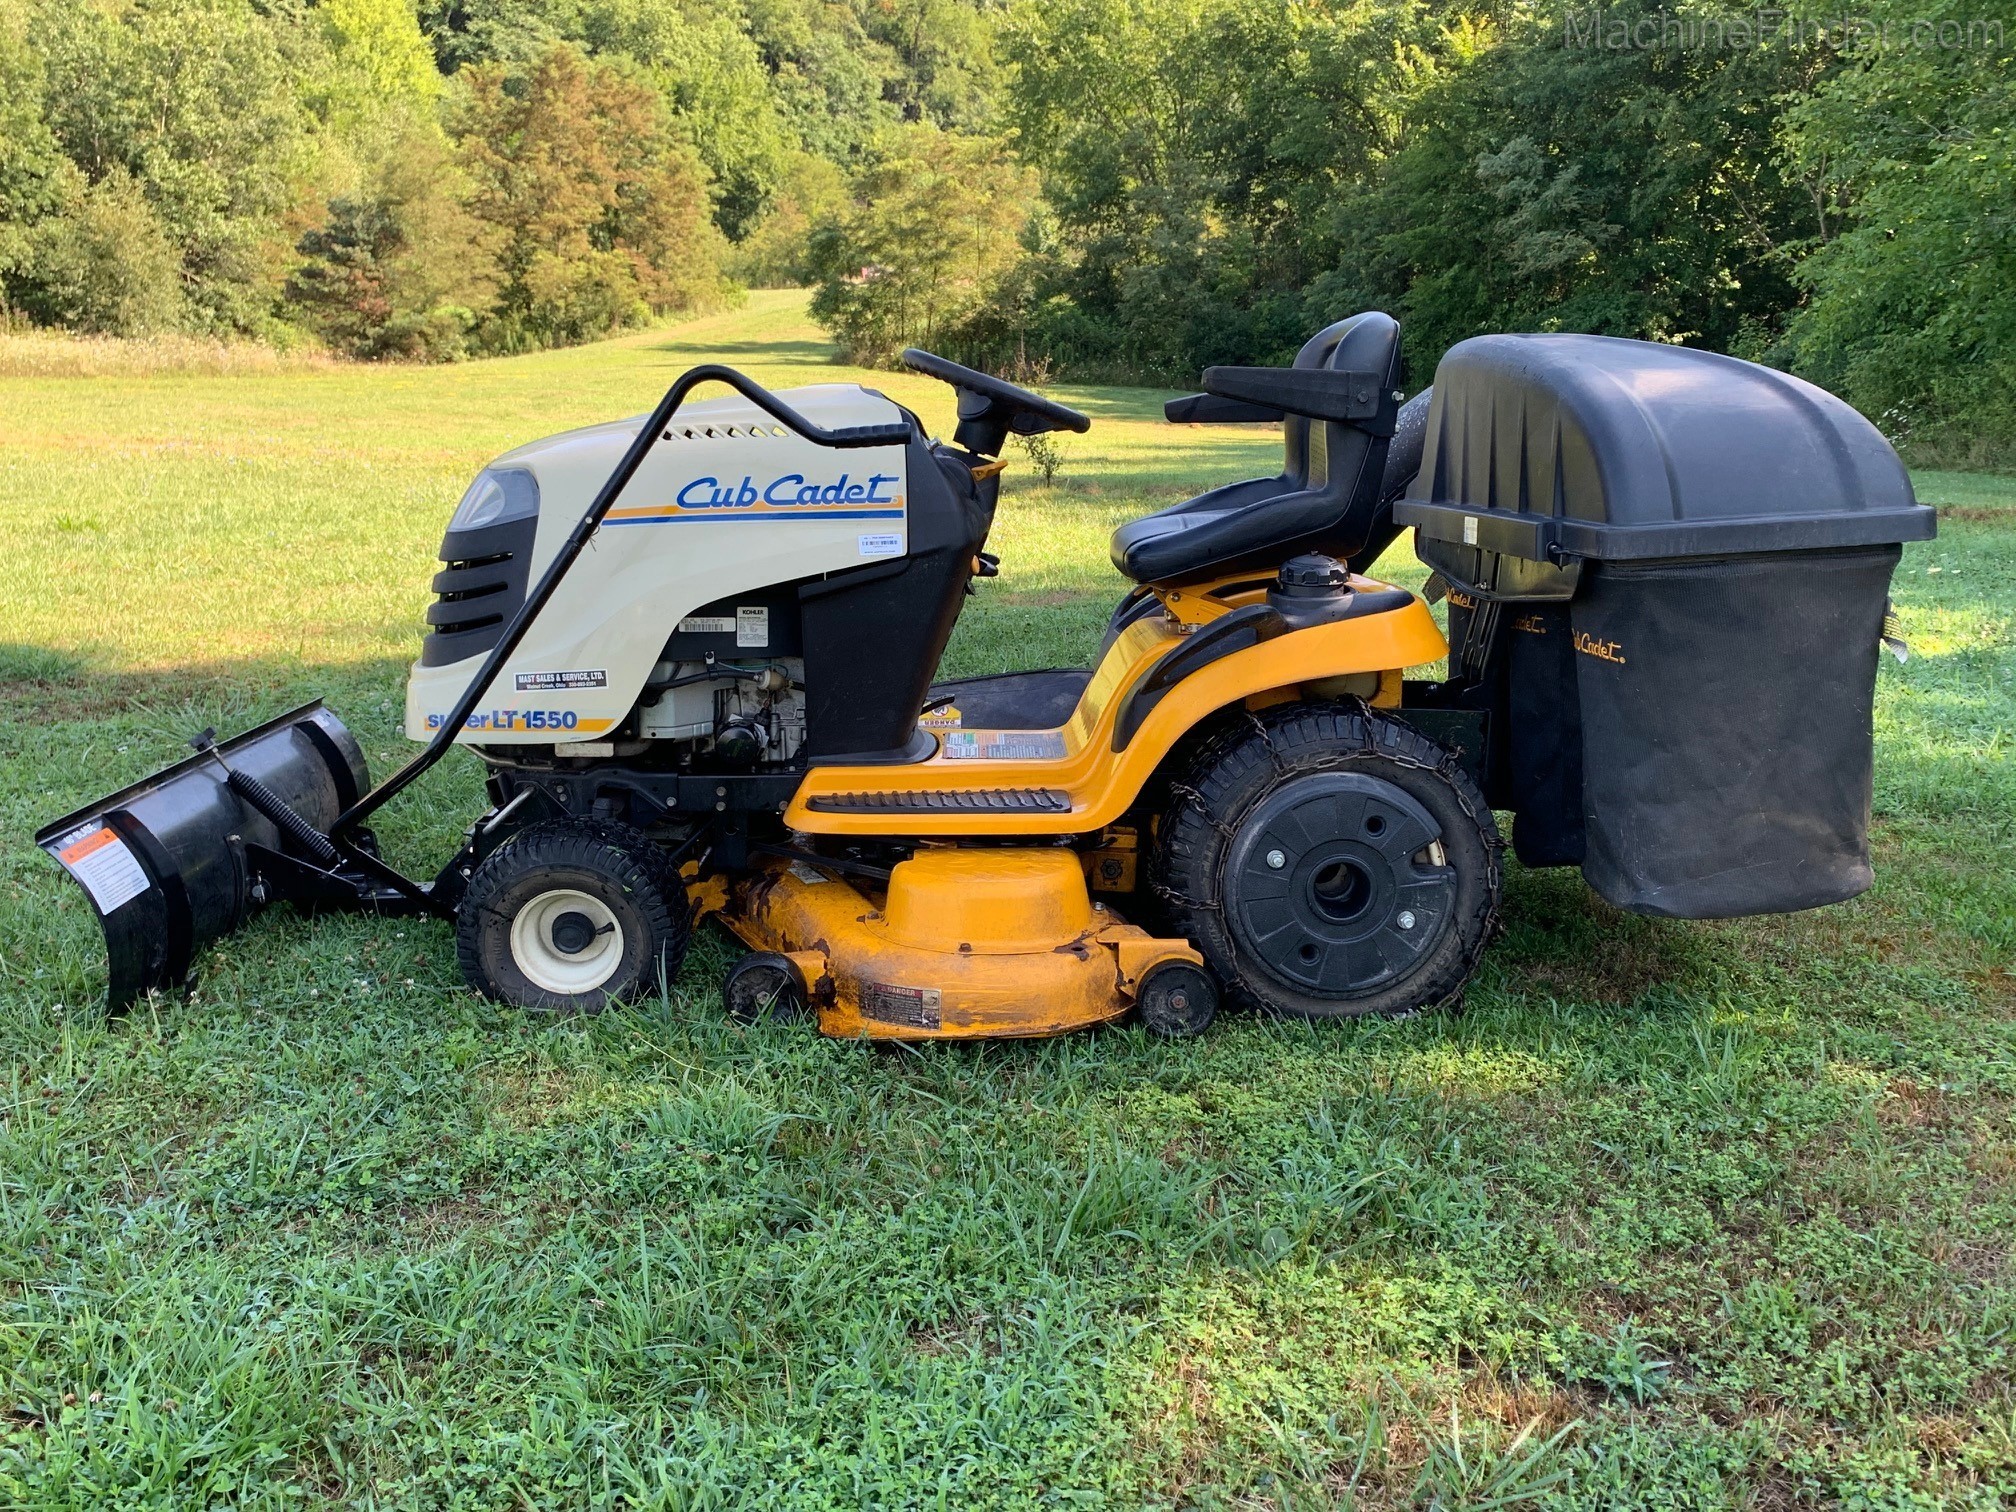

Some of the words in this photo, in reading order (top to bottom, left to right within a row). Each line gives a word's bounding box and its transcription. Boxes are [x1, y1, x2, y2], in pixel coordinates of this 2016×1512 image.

[677, 477, 758, 508] Cub
[764, 474, 899, 505] Cadet
[1581, 633, 1622, 662] Cadet
[518, 674, 535, 683] MAST
[536, 674, 555, 682] SALES
[556, 674, 561, 682] &
[562, 672, 590, 681] SERVICE,
[591, 672, 604, 680] LTD.
[427, 714, 490, 728] suer
[492, 710, 518, 728] LT
[521, 710, 578, 729] 1550
[887, 986, 916, 996] DANGER
